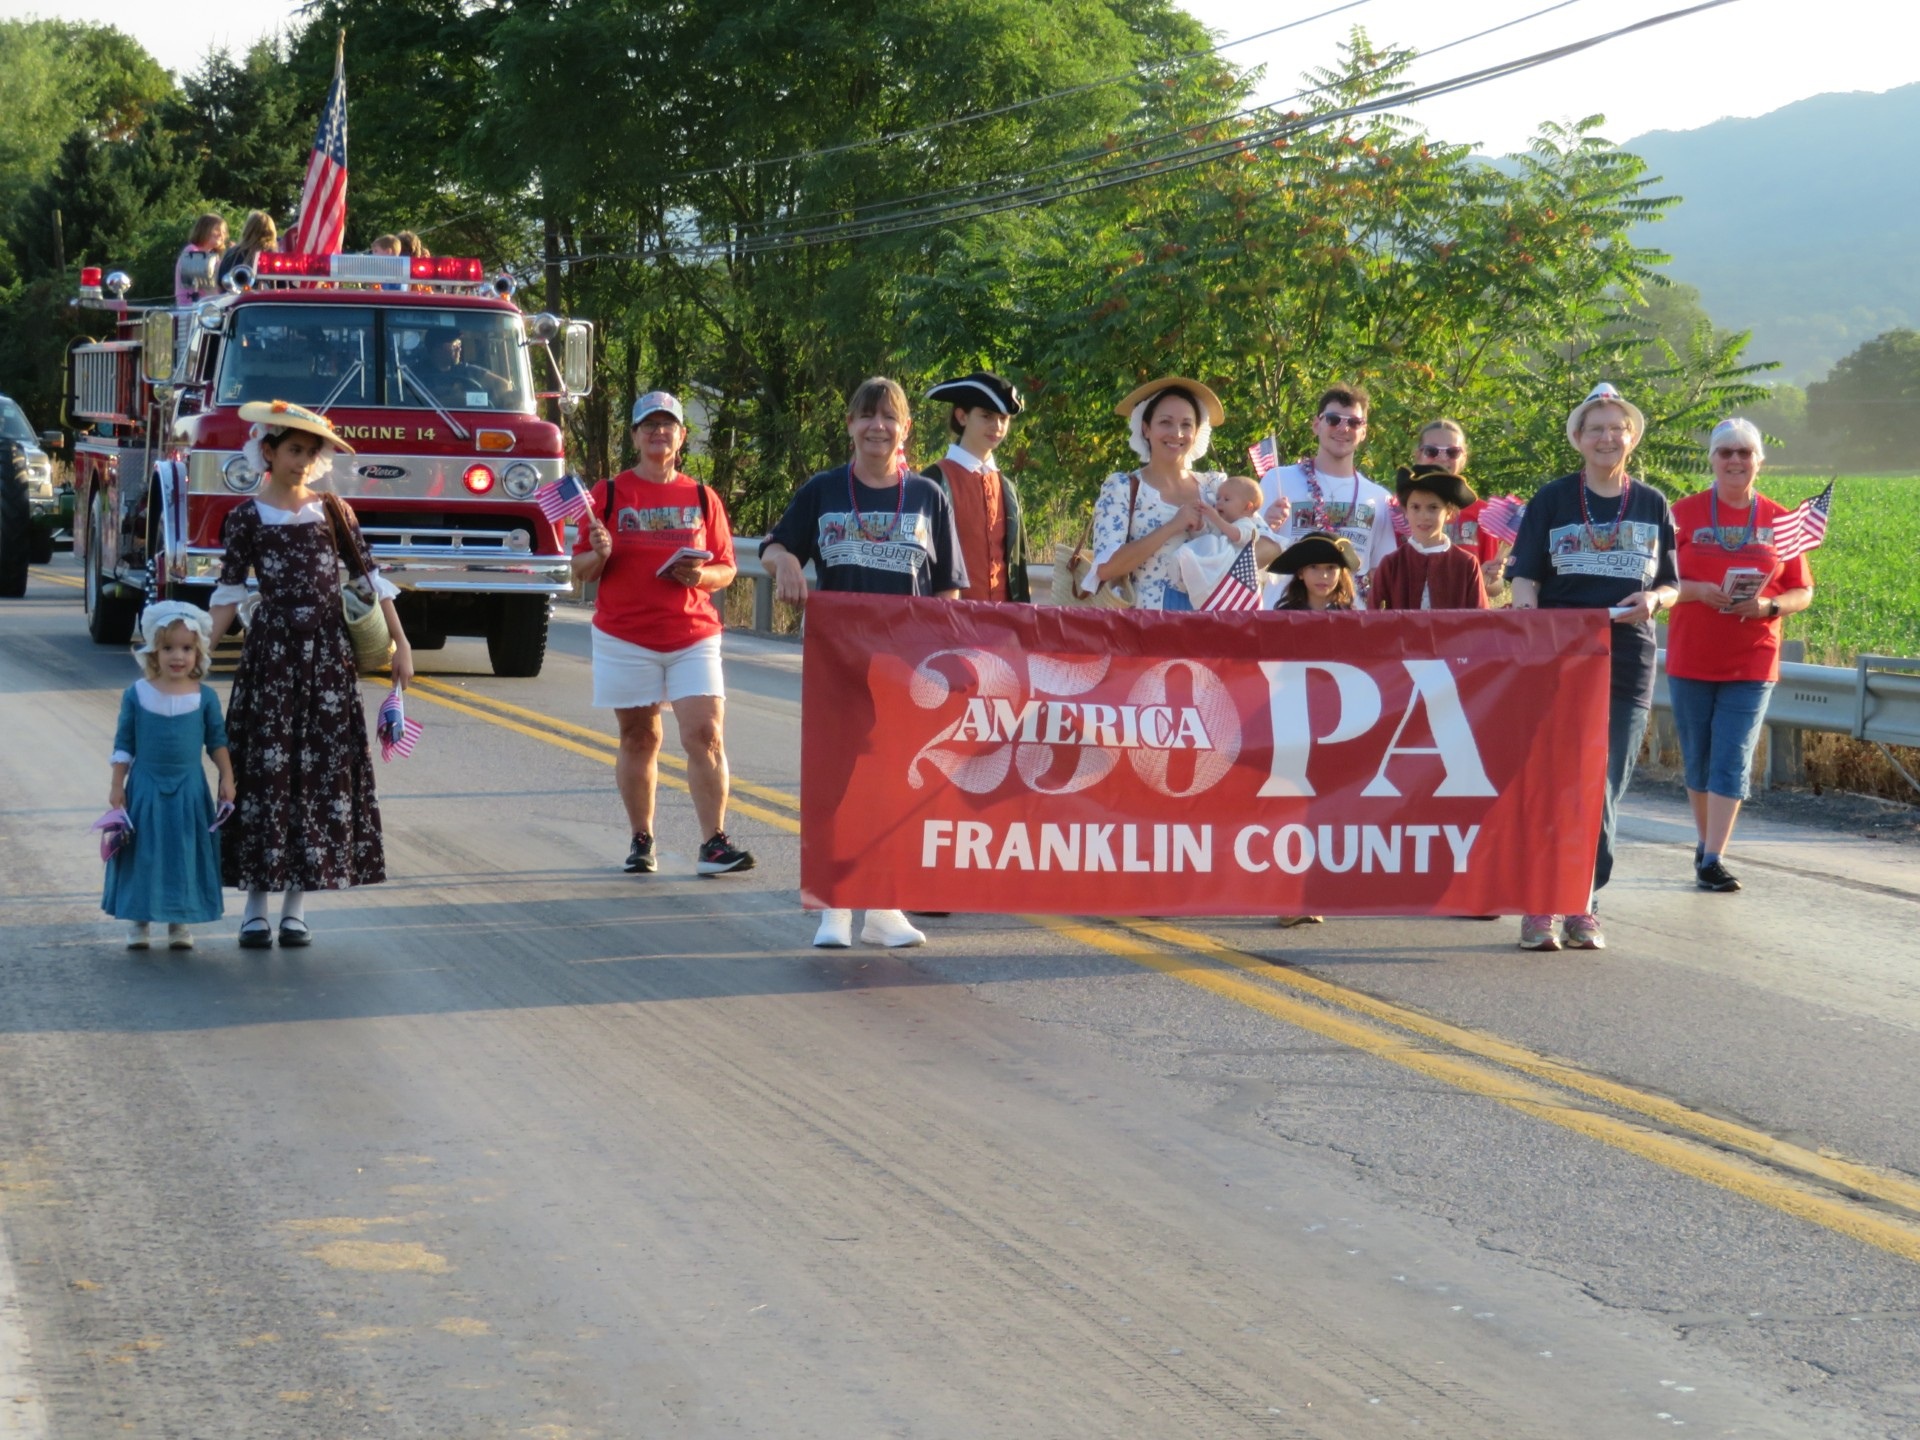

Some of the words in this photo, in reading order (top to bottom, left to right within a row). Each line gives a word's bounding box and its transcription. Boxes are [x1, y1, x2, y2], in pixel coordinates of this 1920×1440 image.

[333, 425, 406, 440] ENGINE
[417, 427, 436, 441] 14
[364, 465, 400, 478] Pierce
[1596, 553, 1643, 567] COUN
[907, 648, 1242, 798] 250
[1255, 659, 1499, 798] PA
[952, 697, 1213, 750] AMERICA
[921, 819, 1212, 873] FRANKLIN
[1234, 823, 1481, 875] COUNTY
